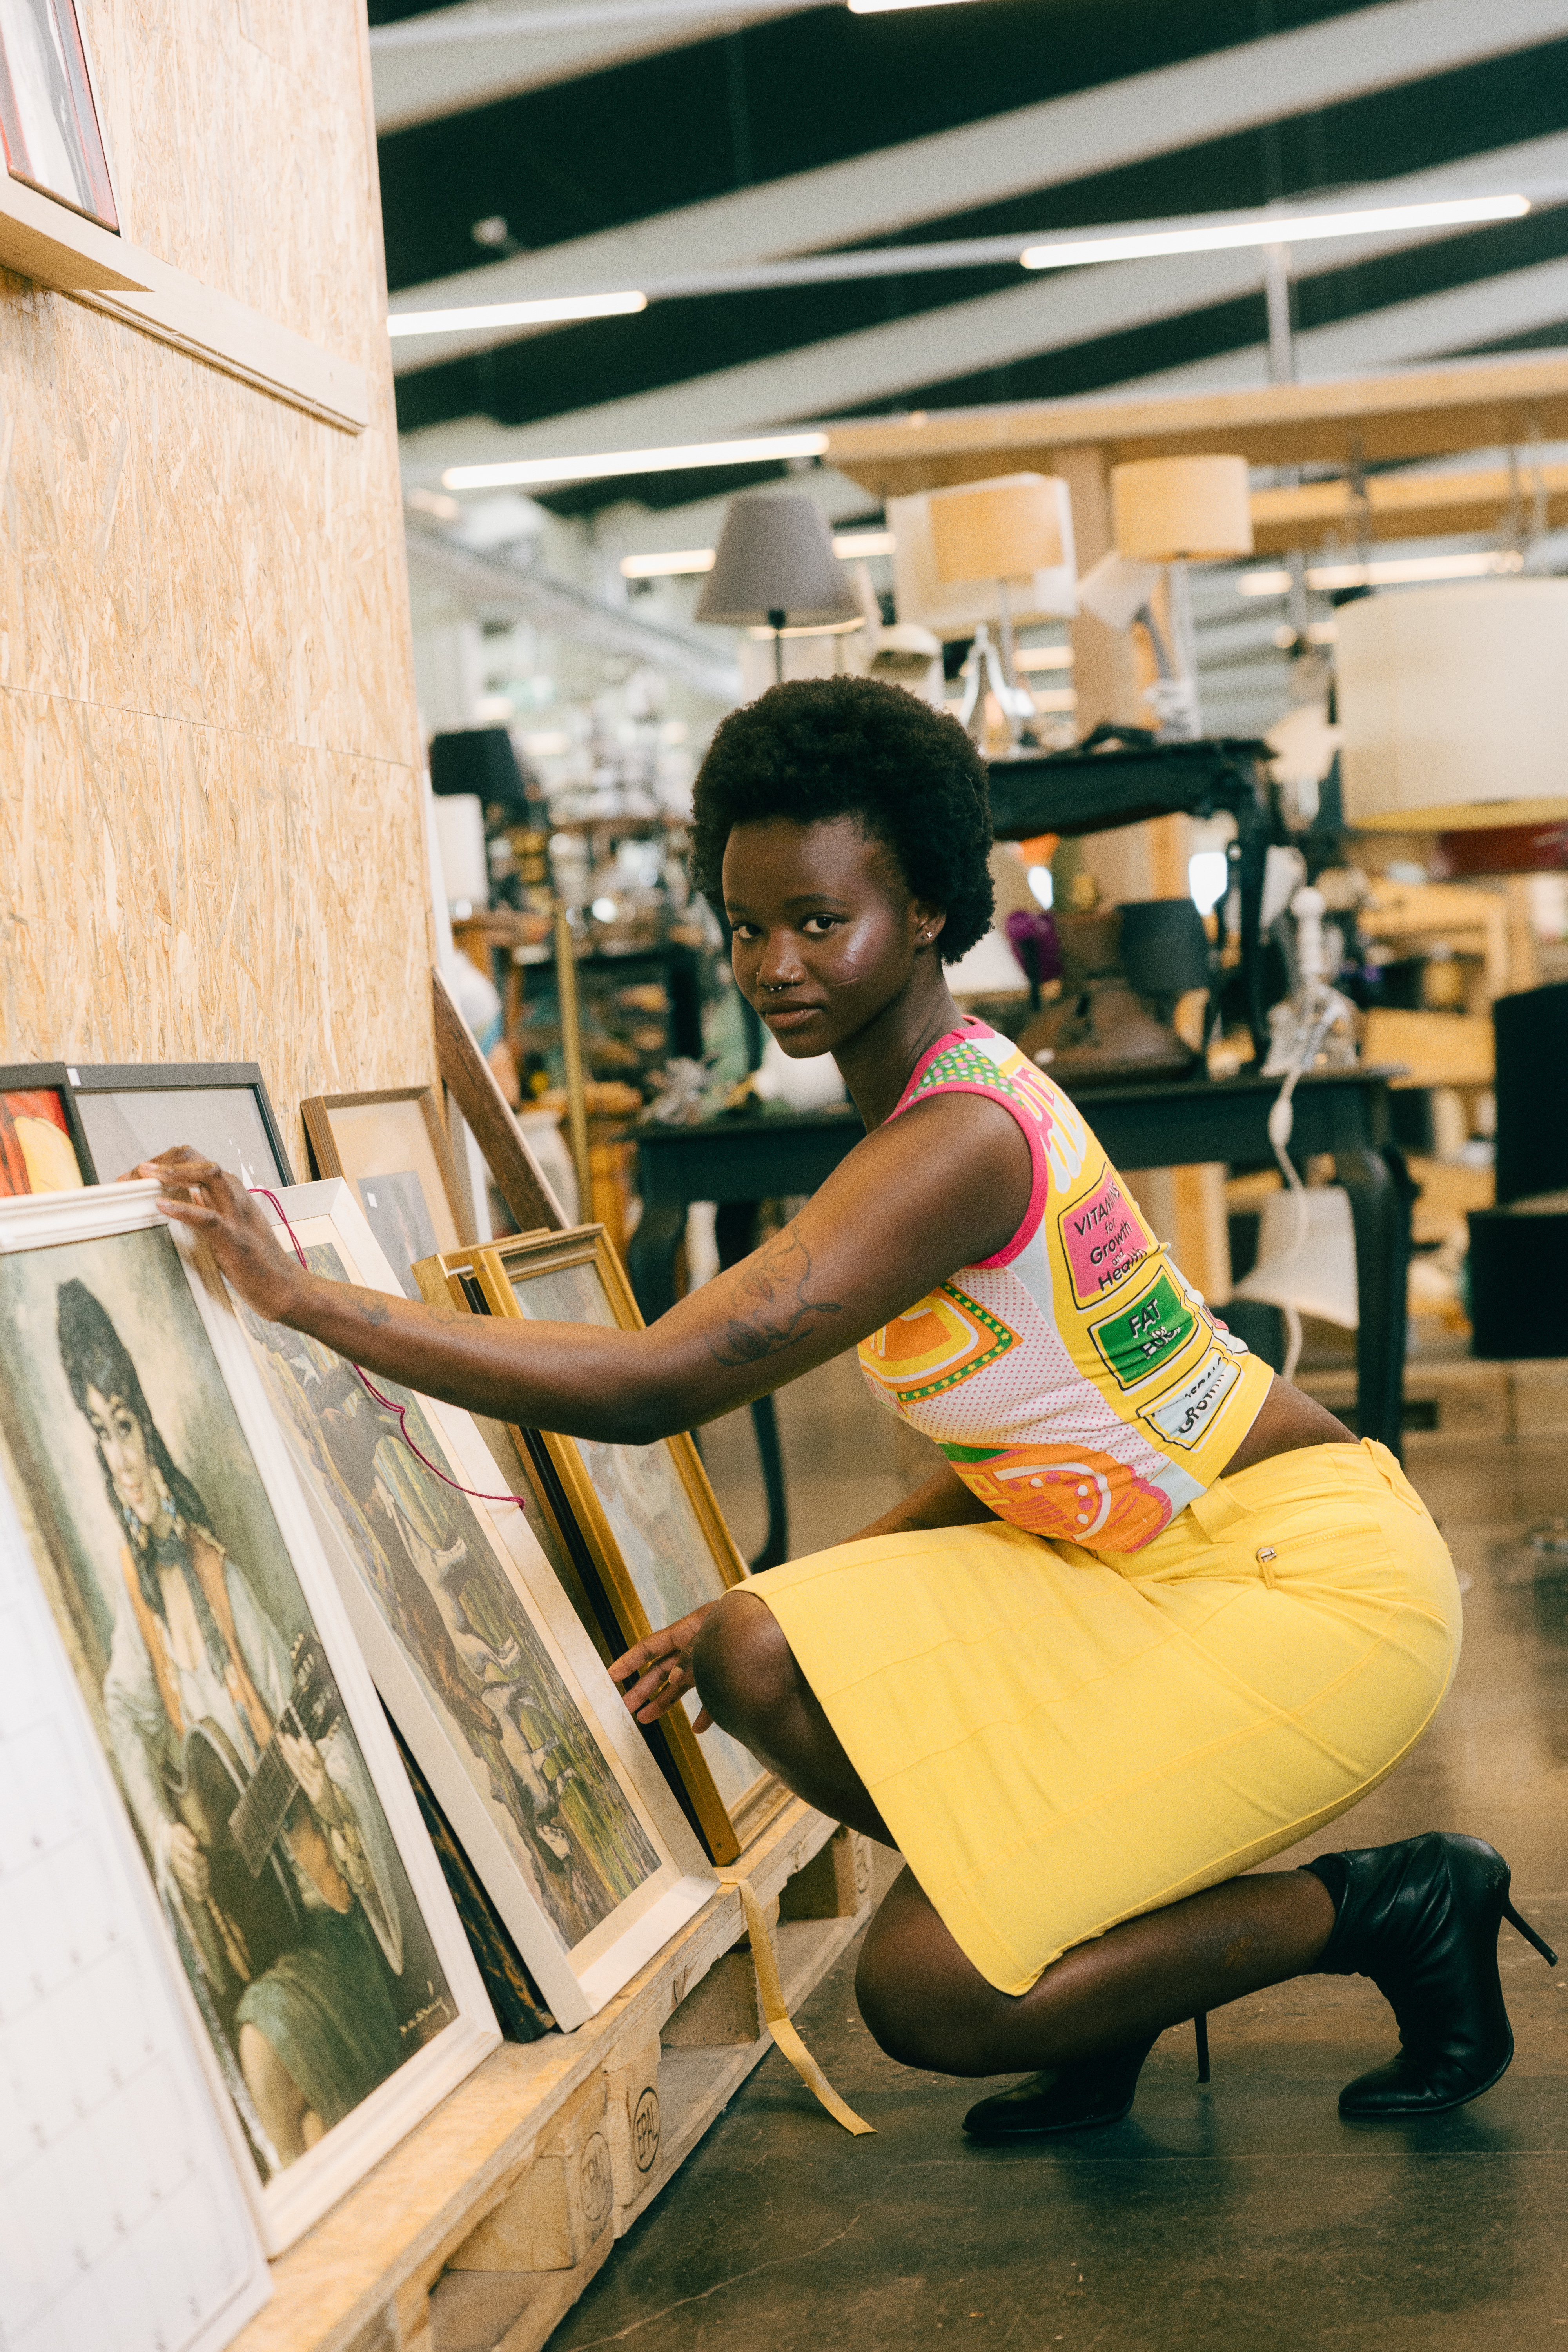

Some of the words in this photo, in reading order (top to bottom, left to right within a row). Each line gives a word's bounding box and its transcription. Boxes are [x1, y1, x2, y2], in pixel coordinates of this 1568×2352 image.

[1074, 1180, 1120, 1236] VITAMINS
[1105, 1218, 1116, 1235] for
[1090, 1220, 1132, 1266] Growth
[1112, 1247, 1125, 1267] and
[1098, 1247, 1147, 1293] Health
[1128, 1298, 1160, 1338] FAT
[637, 2100, 658, 2160] EPAL
